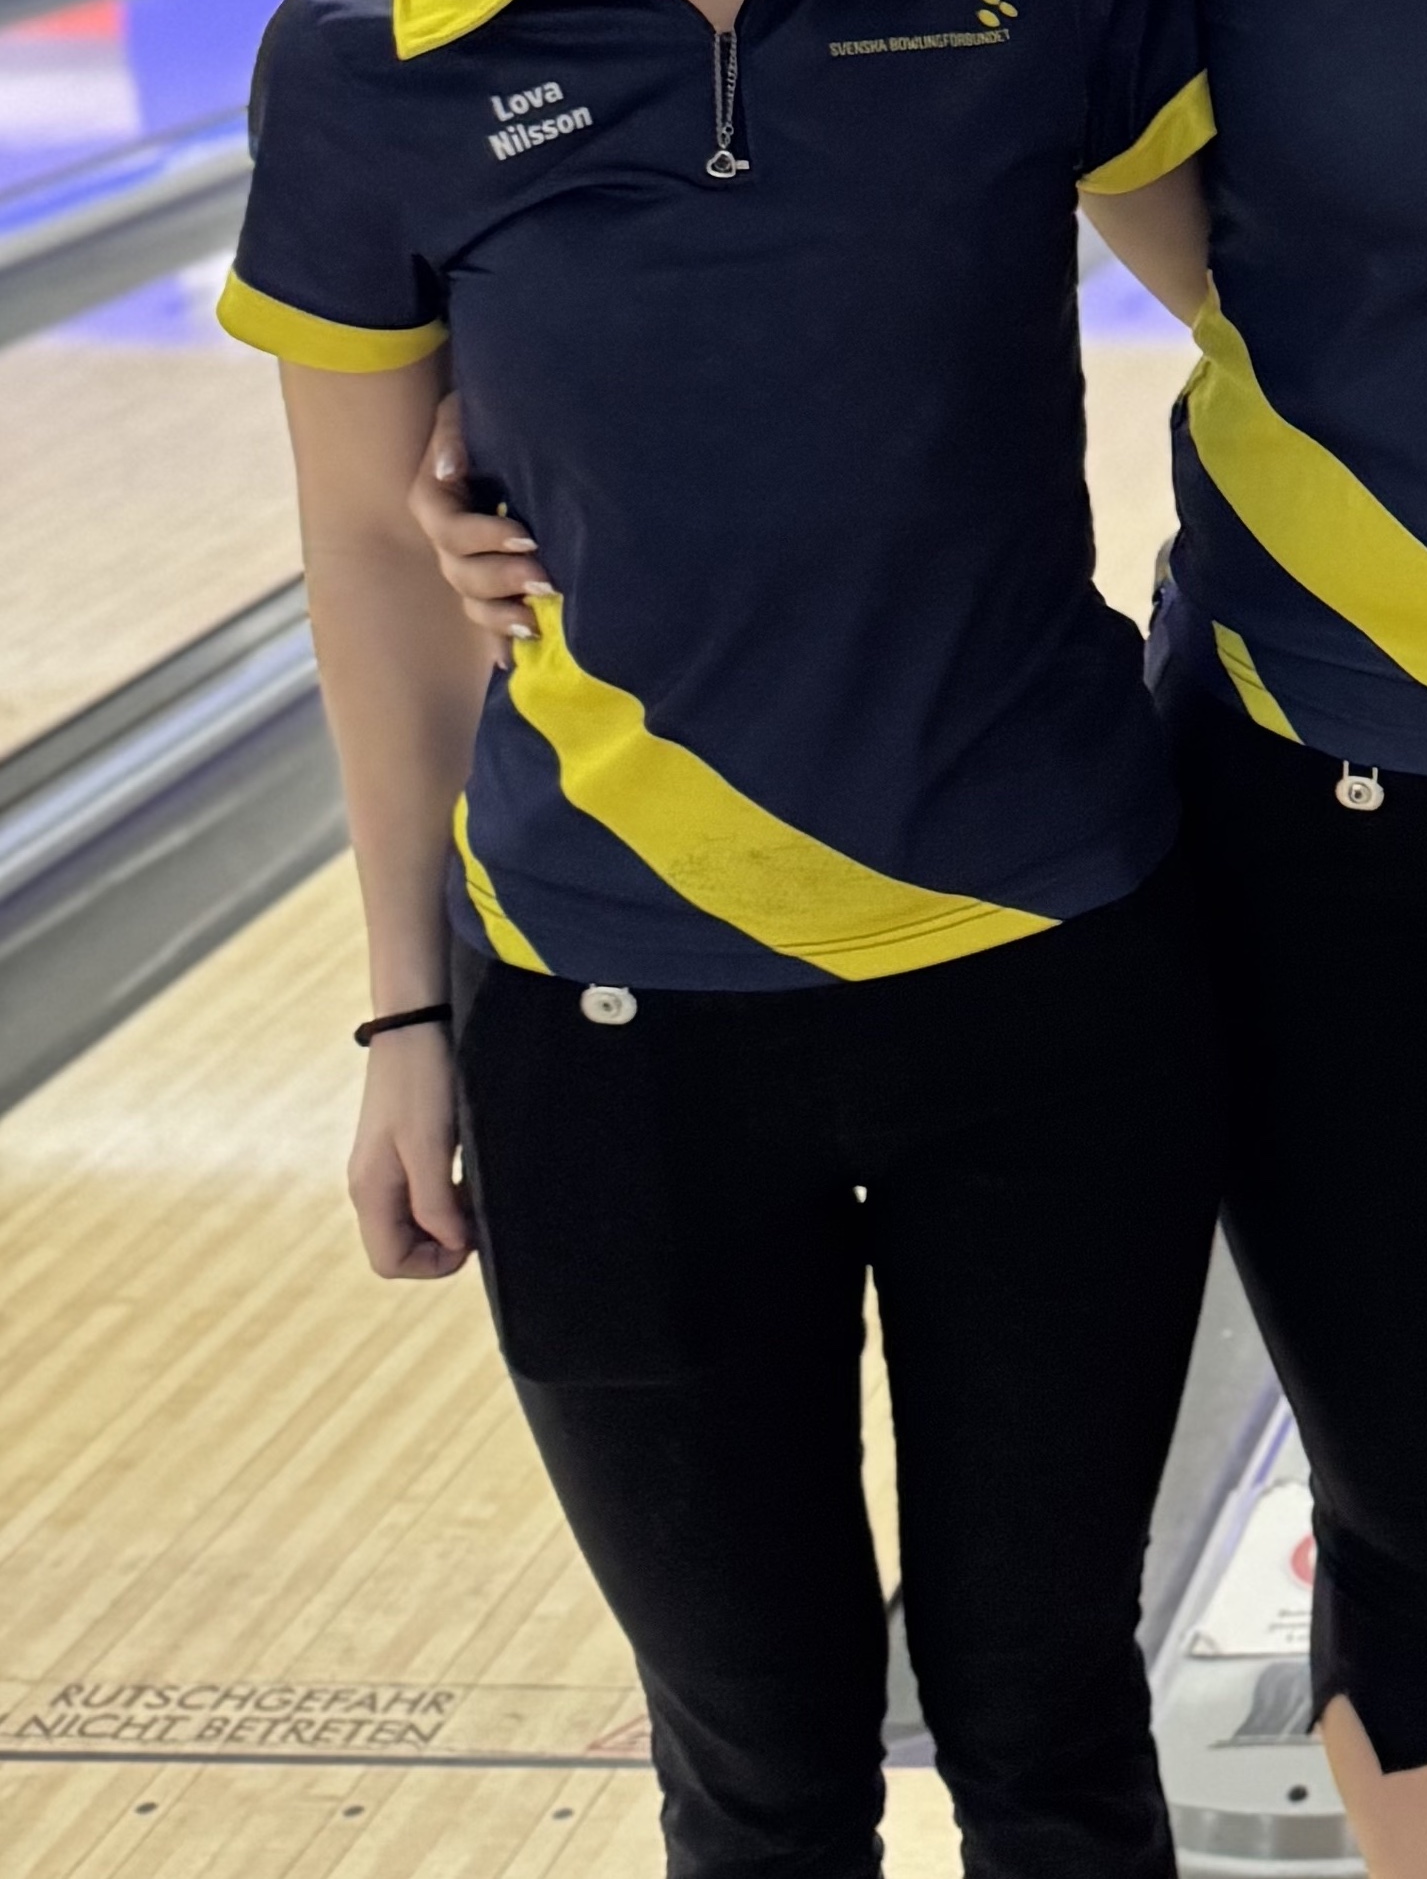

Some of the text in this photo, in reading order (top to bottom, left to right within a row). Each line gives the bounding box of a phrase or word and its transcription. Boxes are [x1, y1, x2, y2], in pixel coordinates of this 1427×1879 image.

[490, 81, 564, 122] Lova
[487, 106, 593, 161] Nilsson
[51, 1683, 455, 1715] RUTSCHGEFAHR
[14, 1713, 445, 1747] NICHT BETRETEN
